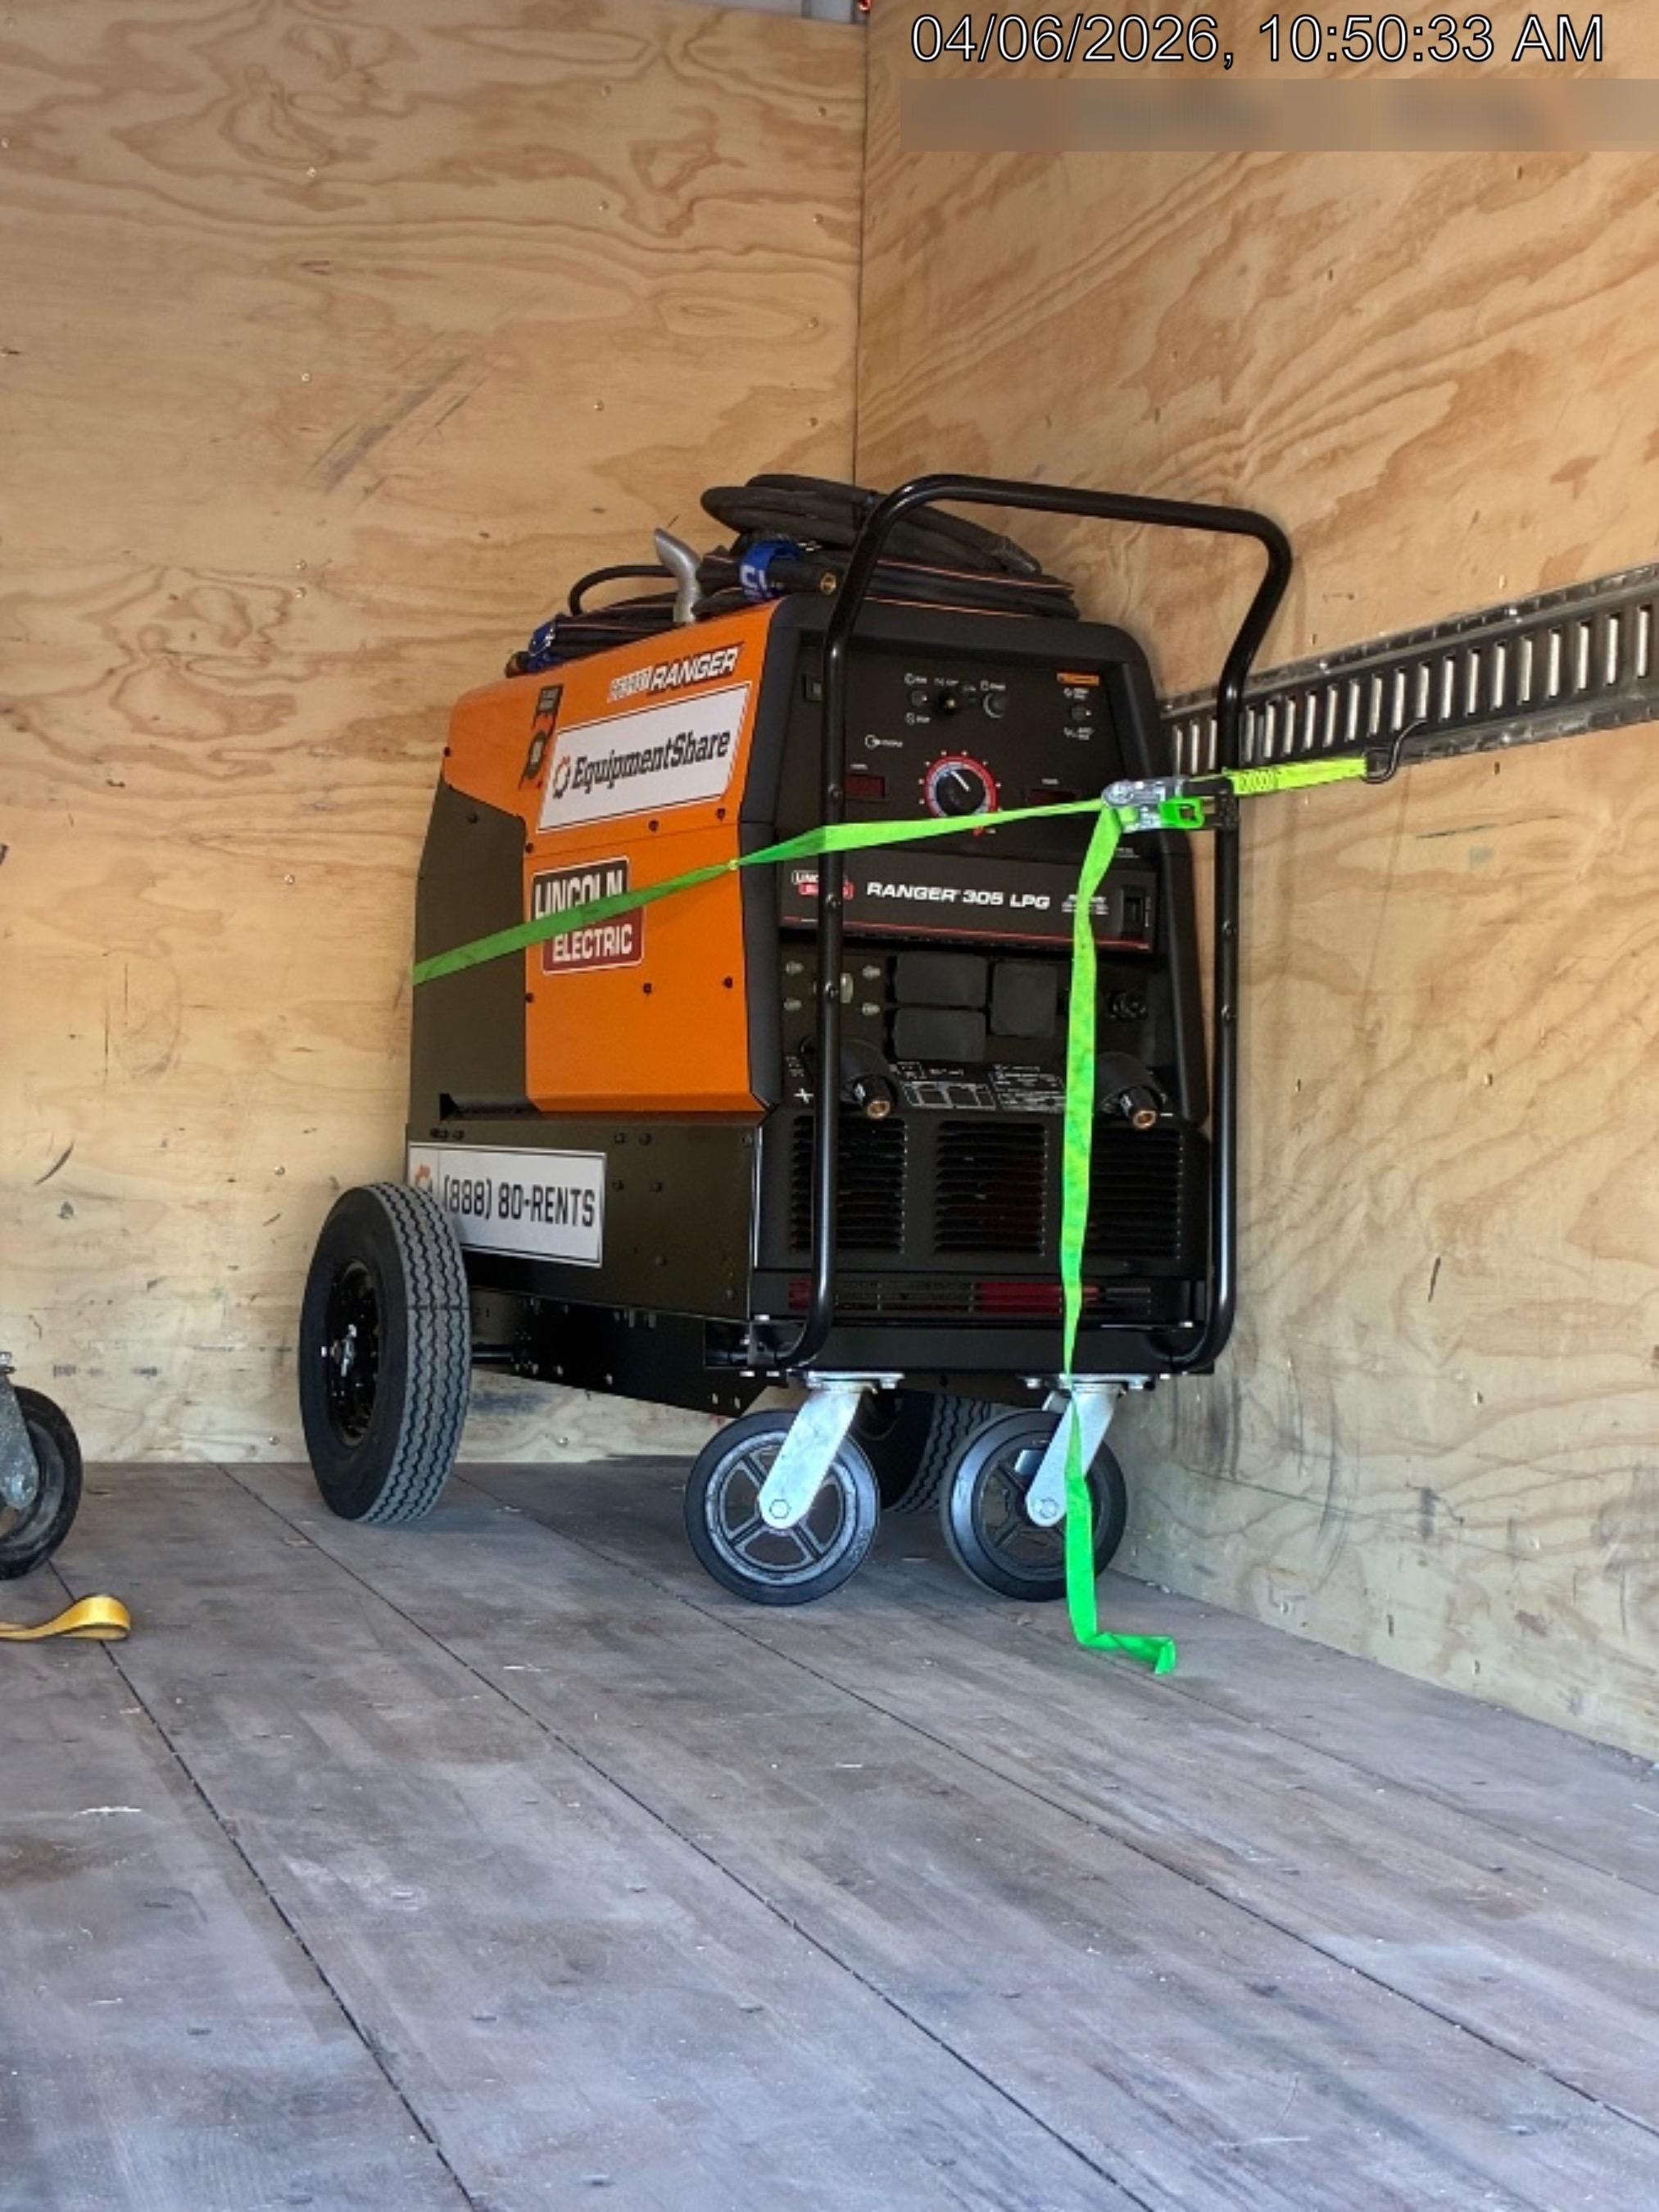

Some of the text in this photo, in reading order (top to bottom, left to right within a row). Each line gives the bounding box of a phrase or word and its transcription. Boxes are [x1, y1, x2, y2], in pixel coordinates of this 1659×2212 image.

[650, 646, 741, 692] RANGER
[570, 730, 731, 794] EquipmentShare
[963, 889, 1004, 906] 305
[1009, 893, 1051, 910] LPG
[551, 923, 633, 963] ELECTRIC
[444, 1174, 596, 1227] (888) 80-RENTS
